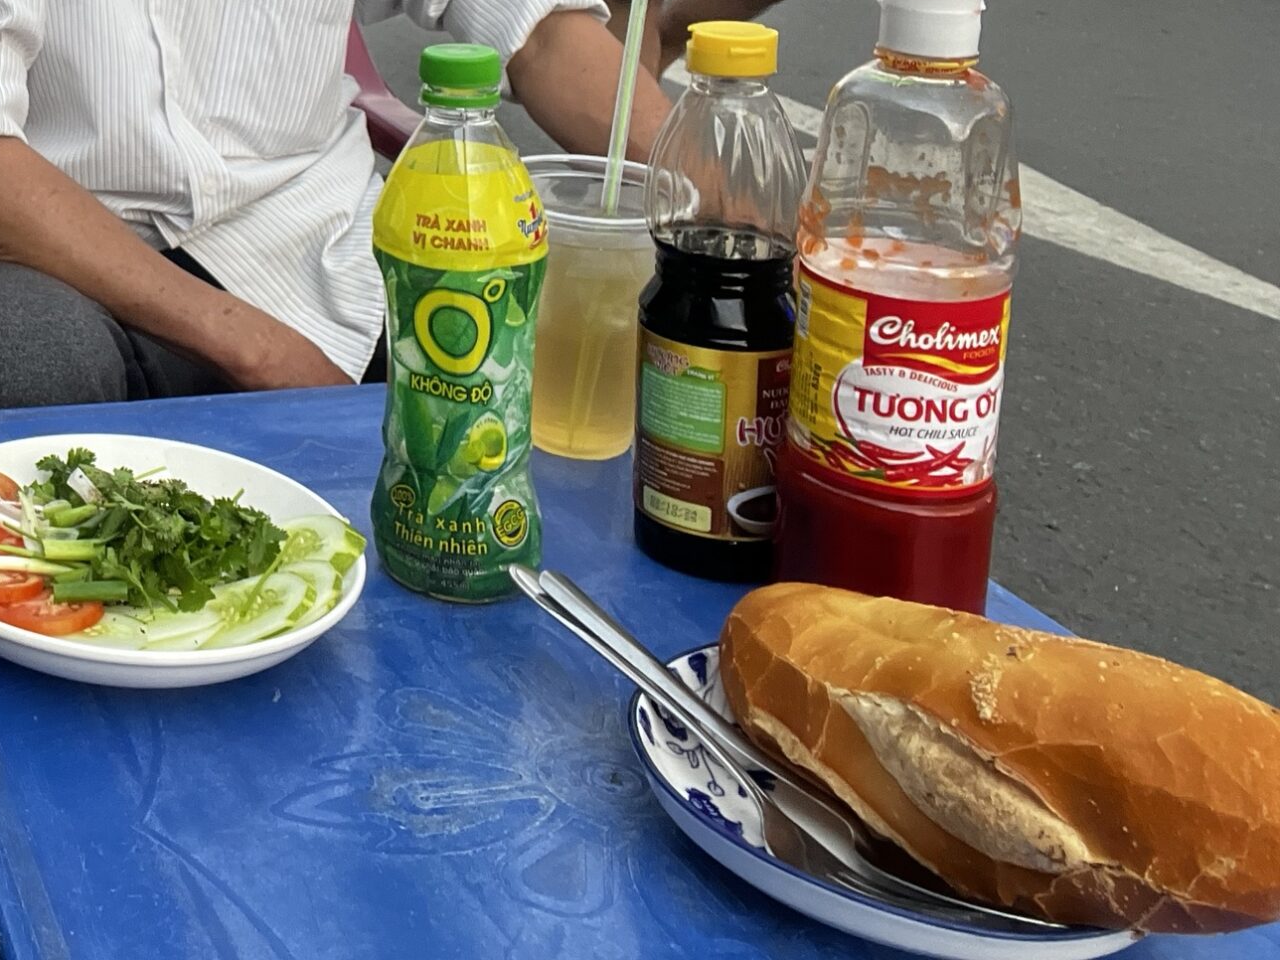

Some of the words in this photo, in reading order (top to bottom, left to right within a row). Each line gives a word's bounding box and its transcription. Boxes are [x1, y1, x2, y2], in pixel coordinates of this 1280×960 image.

[416, 214, 440, 230] TRÀ
[445, 218, 487, 233] XANH
[412, 231, 426, 249] VỊ
[430, 236, 490, 251] CHANH
[869, 316, 1000, 350] Cholimex
[410, 374, 467, 402] KHÔNG
[470, 381, 493, 404] ĐỘ
[864, 367, 895, 376] TASTY
[910, 371, 959, 392] DELICIOUS
[854, 386, 969, 424] TƯƠNG
[889, 425, 914, 438] HOT
[917, 428, 947, 439] CHILI
[949, 426, 980, 439] SAUCE
[399, 502, 424, 524] Trà
[436, 517, 486, 533] xanh
[394, 521, 433, 549] Thiên
[439, 539, 488, 555] nhiên
